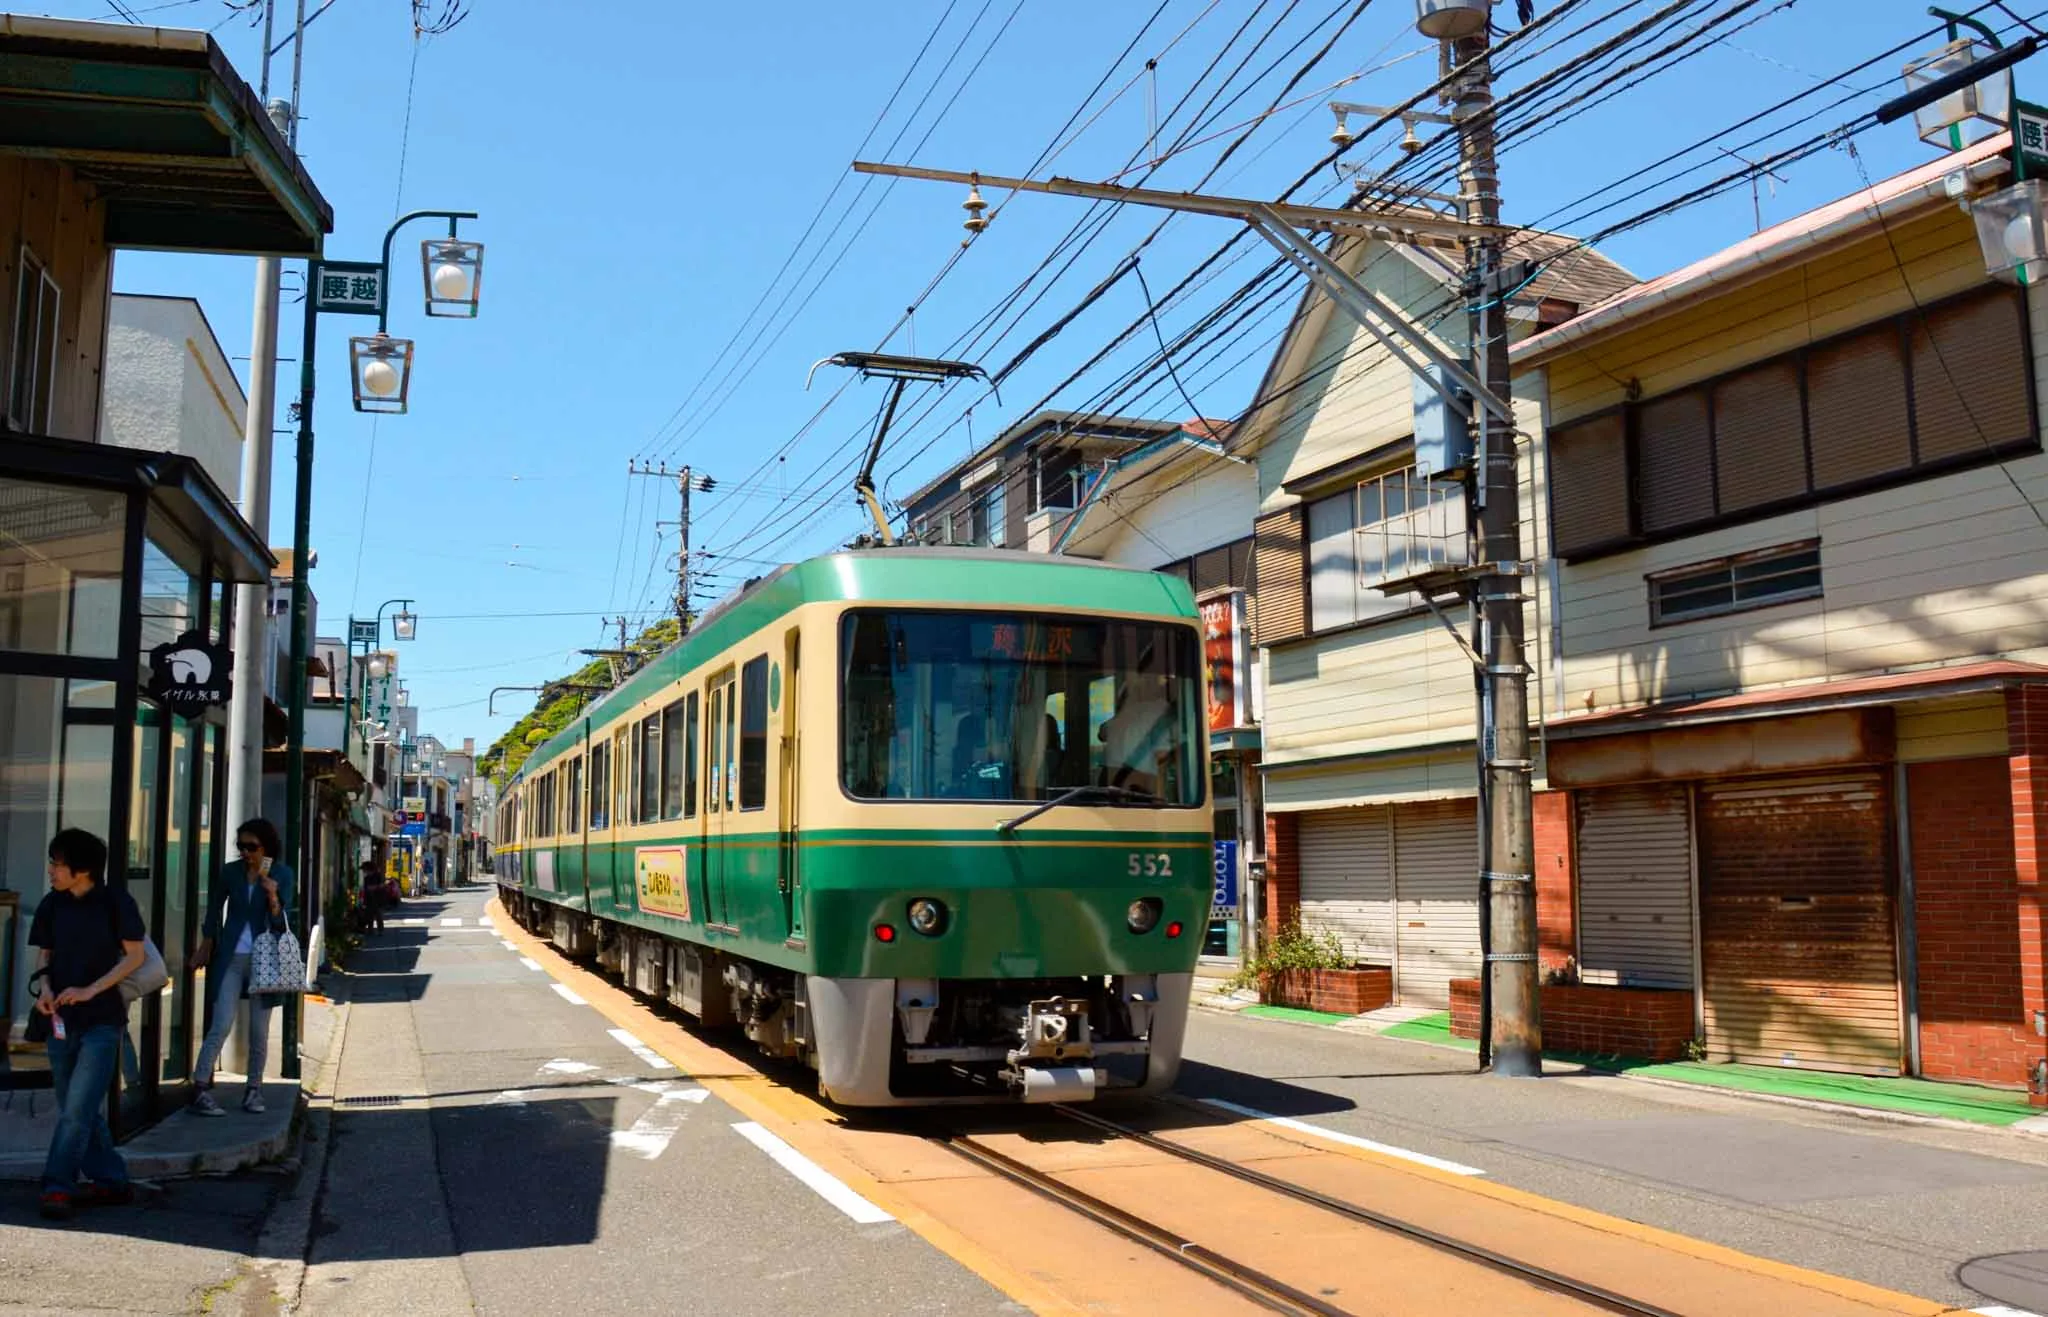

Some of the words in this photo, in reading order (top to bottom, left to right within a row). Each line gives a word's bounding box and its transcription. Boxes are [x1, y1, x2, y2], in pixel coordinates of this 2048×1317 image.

[2021, 119, 2048, 153] 腰
[322, 276, 378, 300] 腰越
[1128, 853, 1173, 877] 552
[1214, 844, 1228, 905] TOTO
